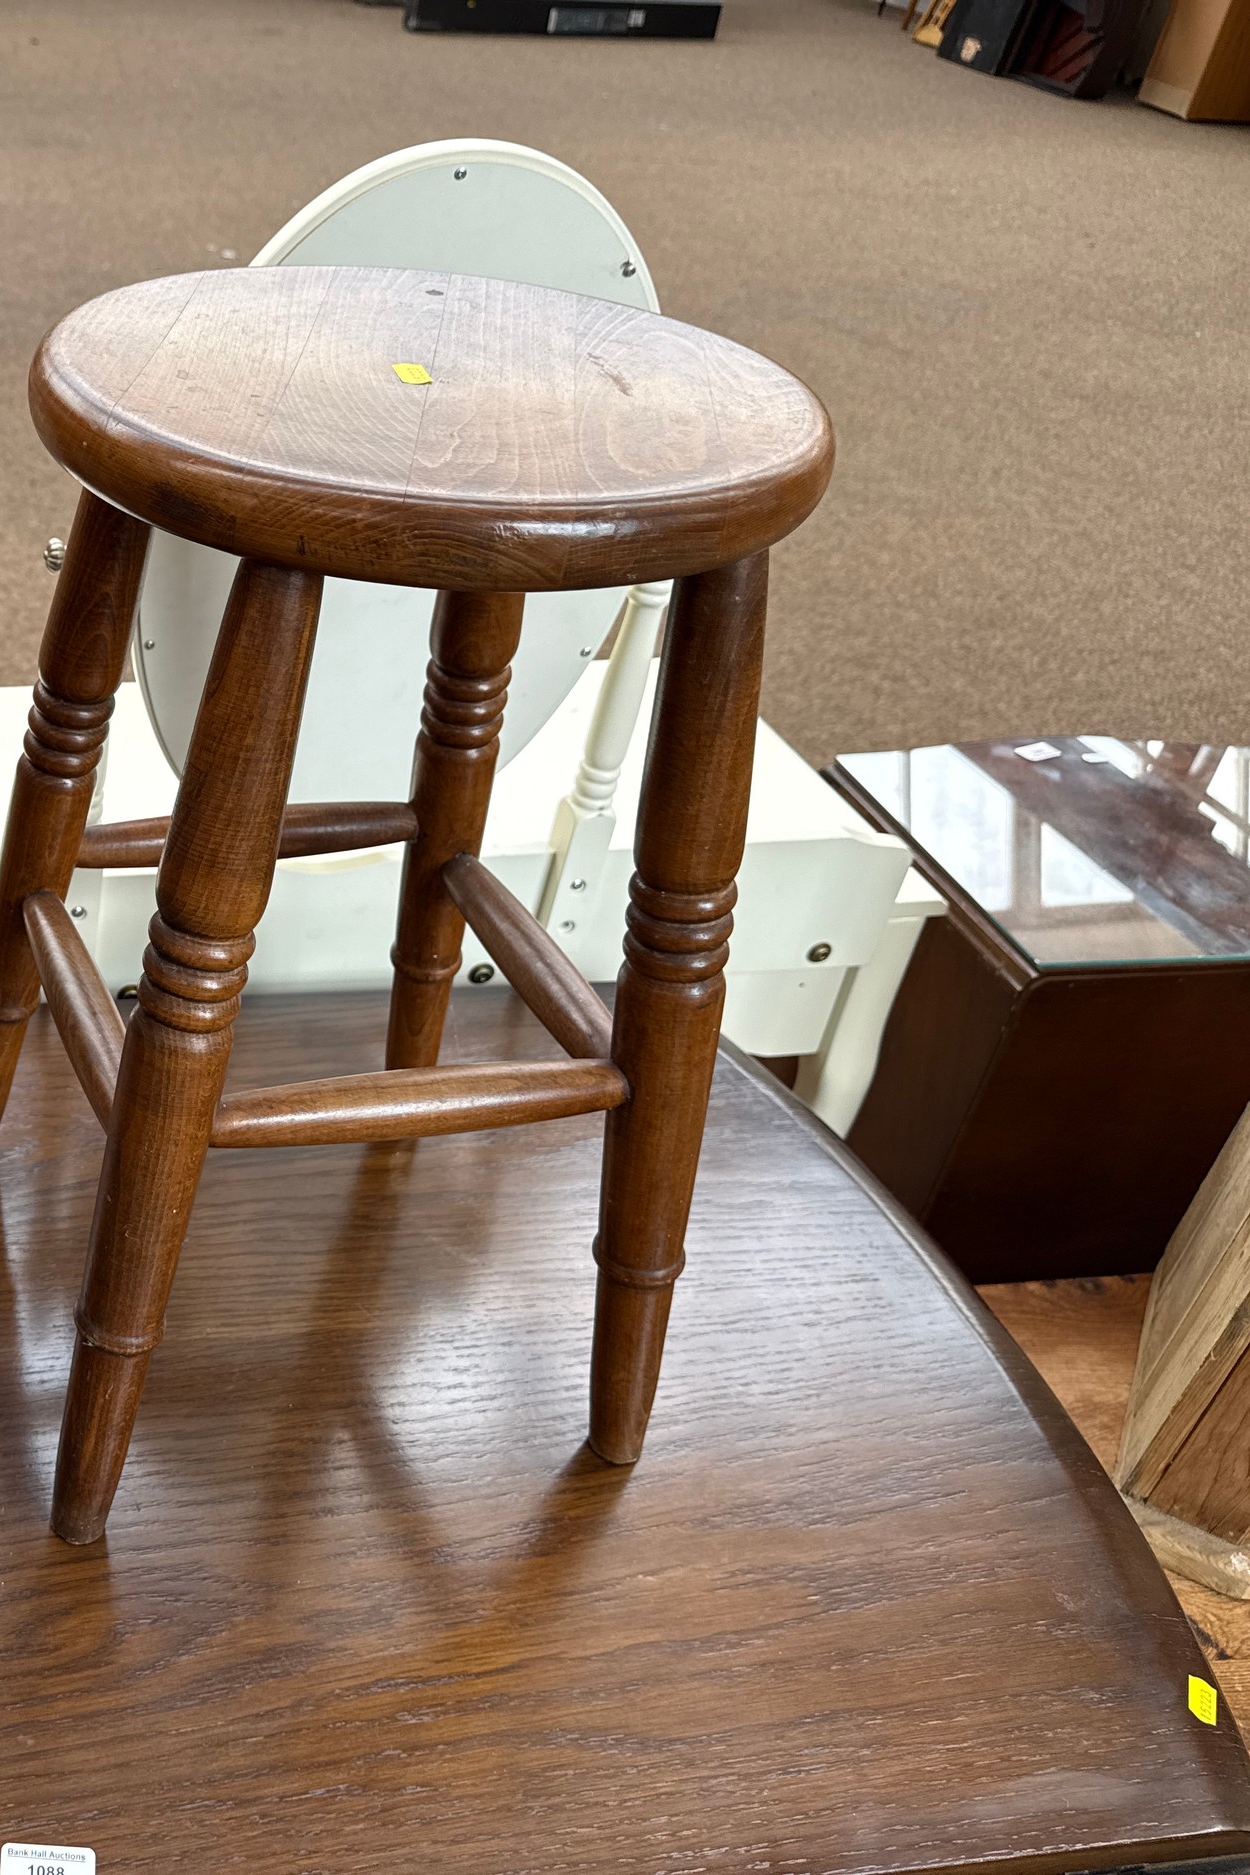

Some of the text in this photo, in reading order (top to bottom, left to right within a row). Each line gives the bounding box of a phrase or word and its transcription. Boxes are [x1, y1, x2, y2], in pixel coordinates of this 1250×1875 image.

[1200, 1688, 1212, 1721] 15223
[7, 1847, 86, 1861] Bank Hall Auctions
[27, 1864, 65, 1875] 1088
